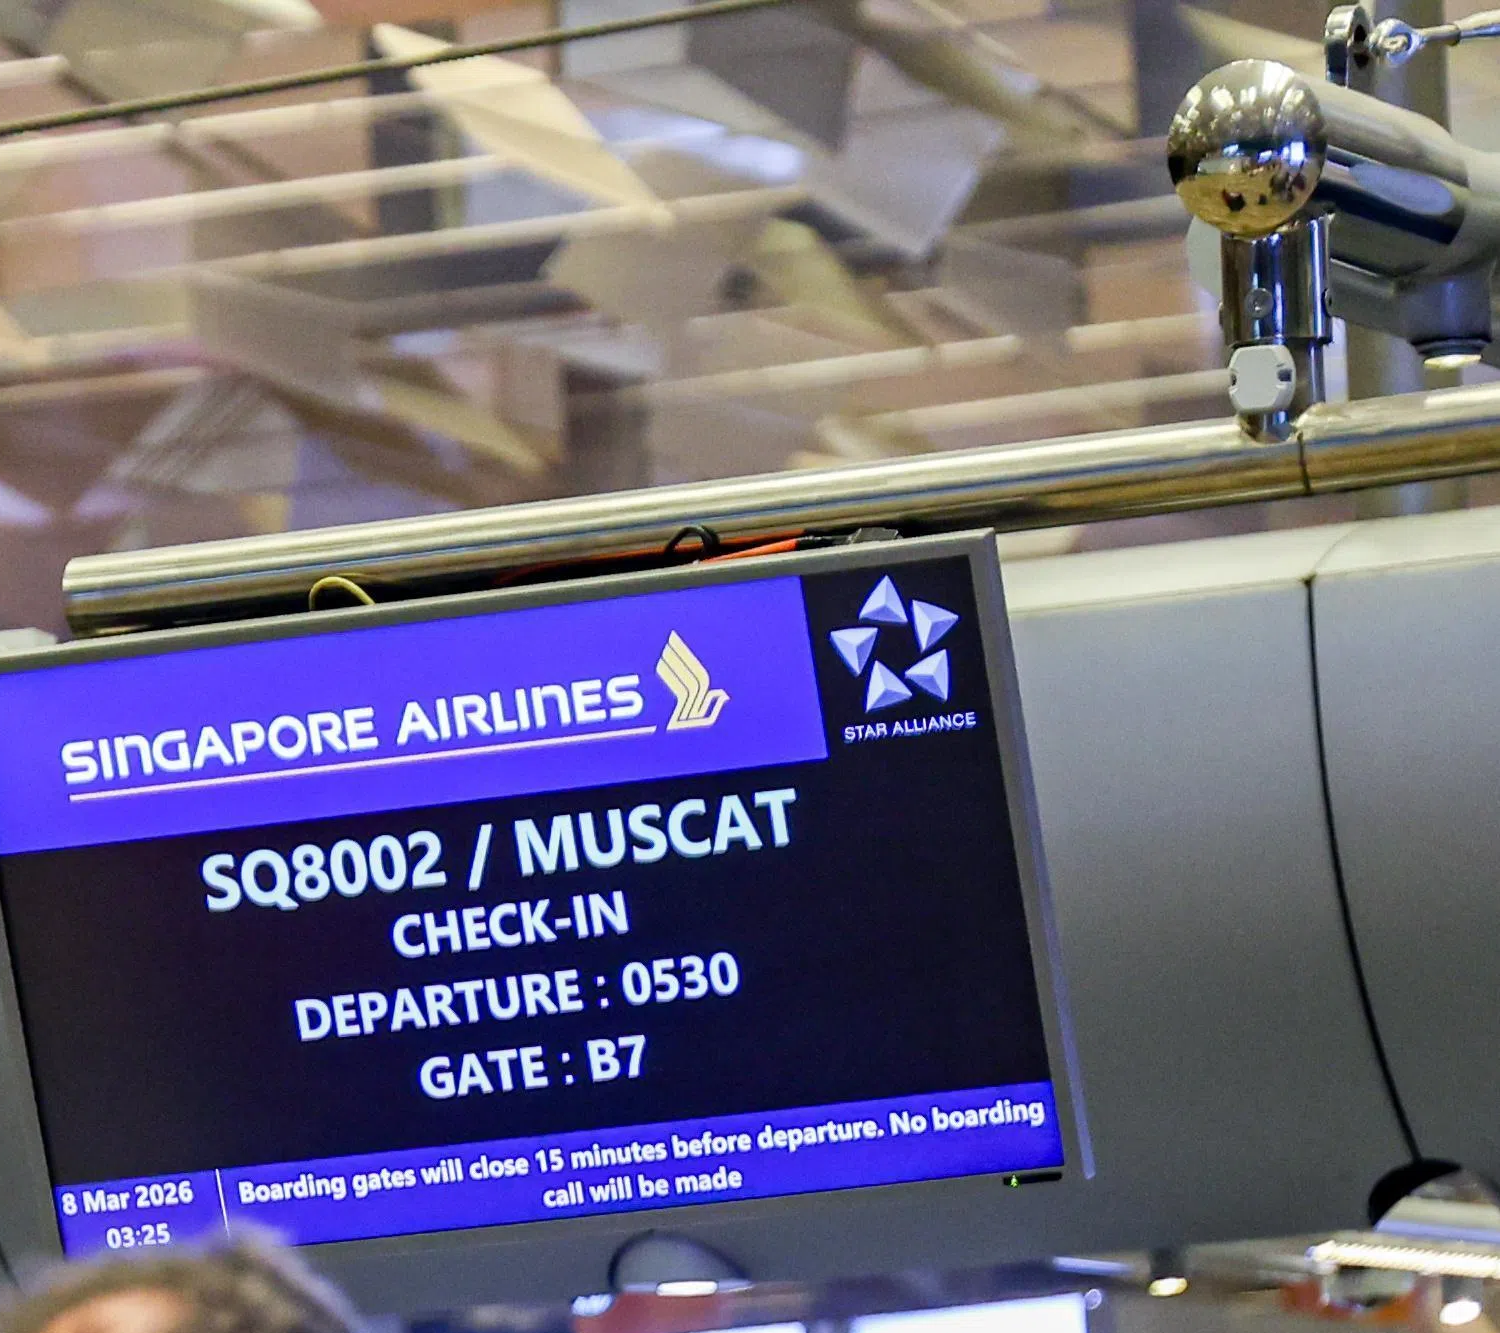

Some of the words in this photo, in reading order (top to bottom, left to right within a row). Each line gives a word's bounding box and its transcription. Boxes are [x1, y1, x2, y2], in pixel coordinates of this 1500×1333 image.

[60, 706, 379, 784] SINGAPORE
[395, 673, 644, 745] AIRLINES
[843, 721, 888, 741] STAR
[891, 710, 976, 736] ALLIANCE
[201, 829, 447, 911] SQ8002
[467, 822, 492, 891] /
[513, 786, 796, 876] MUSCAT
[391, 889, 629, 958] CHECK-IN
[293, 968, 584, 1042] DEPARTURE
[595, 974, 609, 1008] :
[621, 951, 739, 1005] 0530
[419, 1044, 549, 1099] GATE
[560, 1051, 574, 1085] :
[585, 1033, 646, 1082] B7
[237, 1172, 347, 1204] Boarding
[351, 1167, 417, 1198] gates
[419, 1157, 464, 1184] will
[468, 1154, 529, 1180] close
[533, 1147, 564, 1173] 15
[569, 1140, 668, 1169] minutes
[670, 1130, 752, 1159] before
[756, 1119, 885, 1153] departure.
[888, 1110, 927, 1136] No
[930, 1098, 1045, 1131] boarding
[60, 1191, 78, 1216] 8
[81, 1188, 131, 1214] Mar
[133, 1179, 194, 1208] 2026
[542, 1180, 585, 1208] call
[587, 1174, 633, 1203] will
[636, 1173, 669, 1198] be
[673, 1164, 743, 1194] made
[105, 1221, 171, 1251] 03:25
